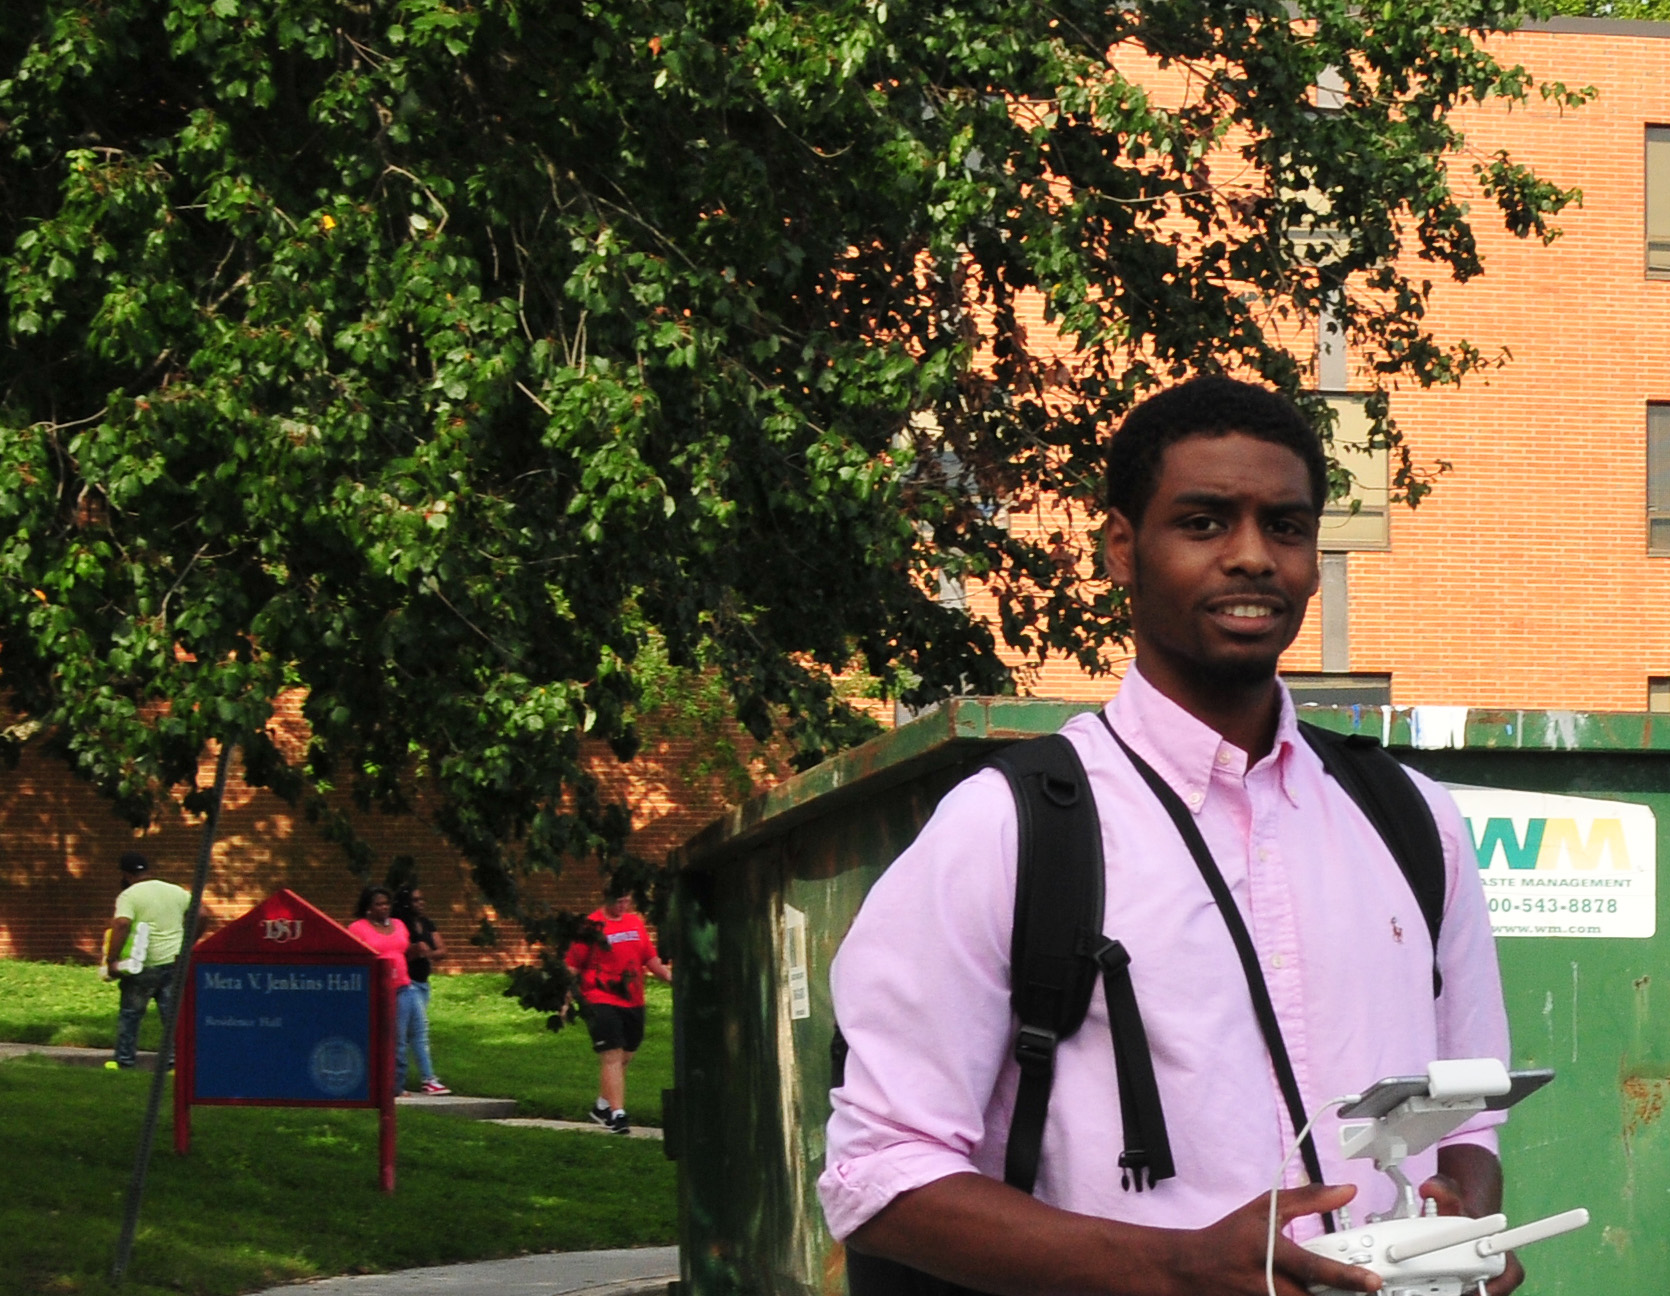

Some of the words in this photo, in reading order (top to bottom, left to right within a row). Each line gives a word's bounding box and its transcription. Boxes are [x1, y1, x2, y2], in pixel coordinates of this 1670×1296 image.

[1464, 817, 1632, 870] WM
[1480, 878, 1516, 887] ASTE
[1521, 878, 1632, 888] MANAGEMENT
[1488, 897, 1618, 913] 00-543-8878
[1491, 925, 1602, 934] www.wm.com
[327, 972, 362, 991] Hall
